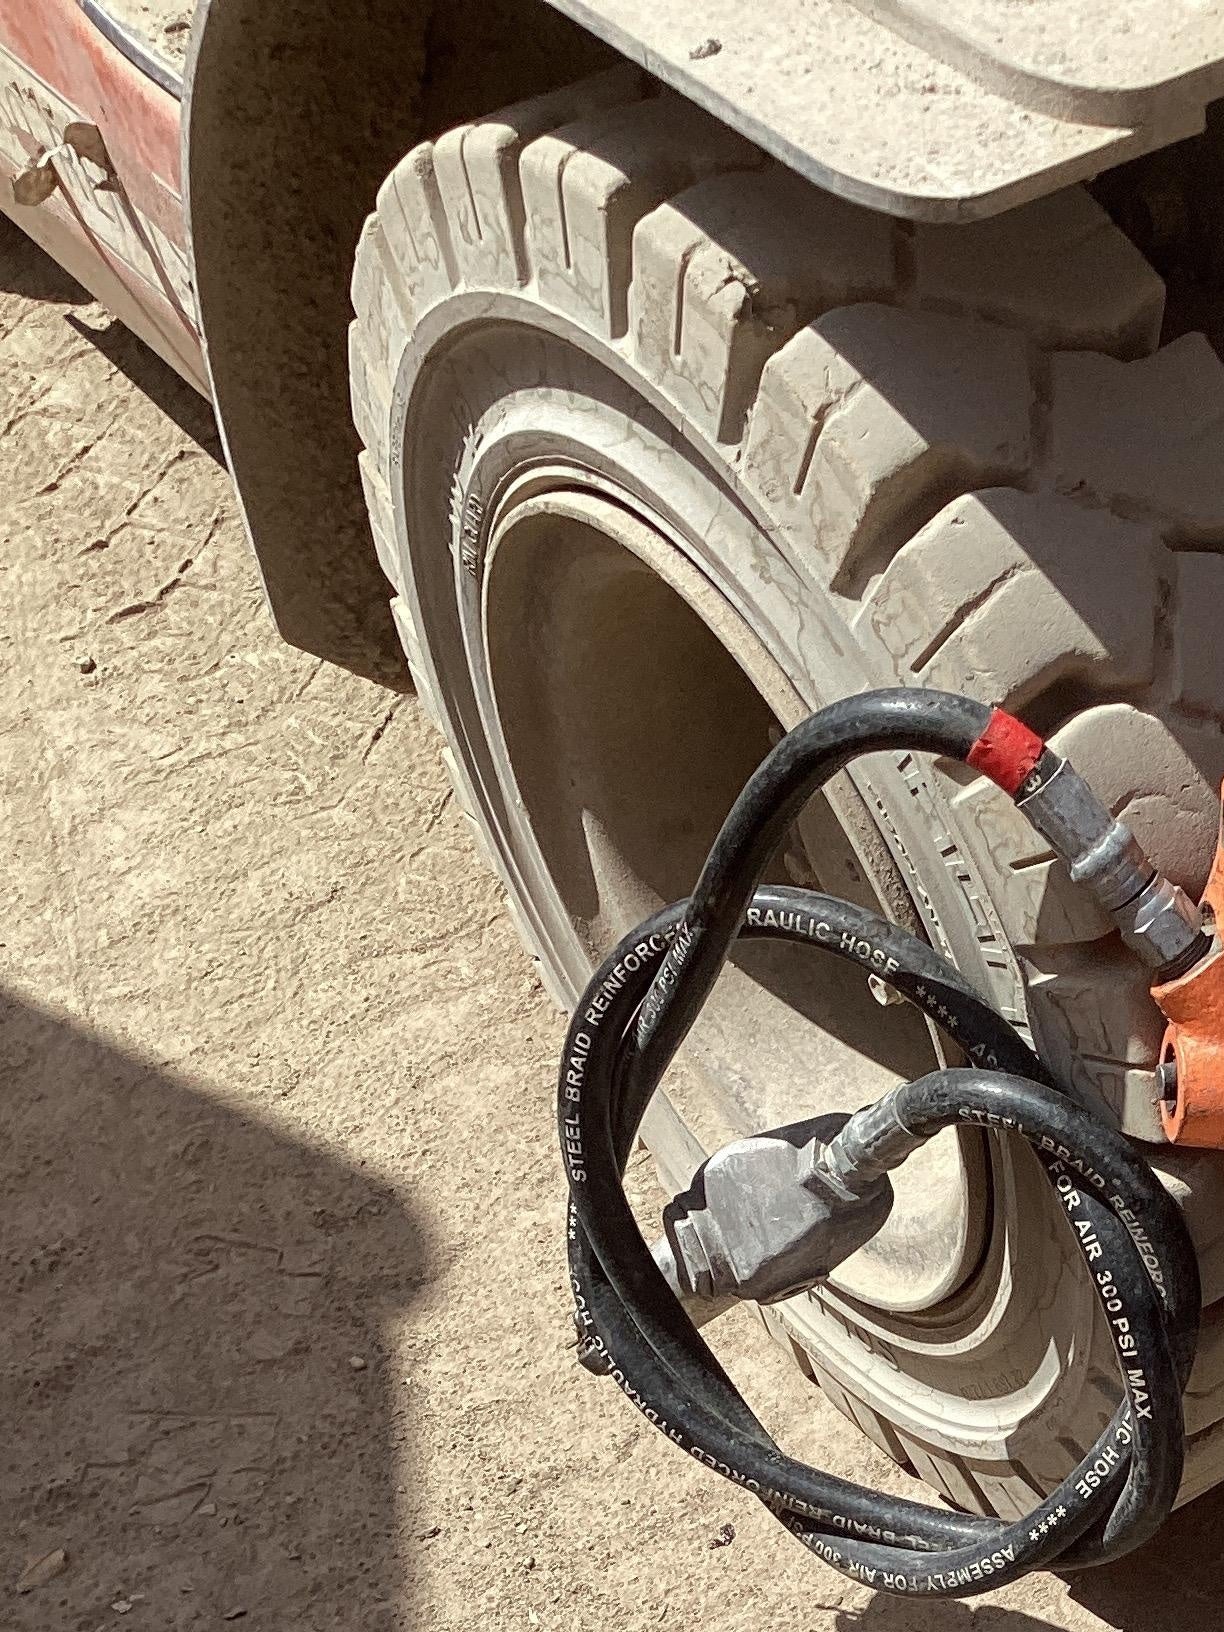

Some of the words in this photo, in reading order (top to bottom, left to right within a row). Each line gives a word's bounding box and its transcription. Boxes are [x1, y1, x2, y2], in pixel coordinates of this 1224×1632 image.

[584, 921, 683, 1026] REINFORCE
[839, 931, 901, 976] HOSE
[565, 1031, 593, 1102] BRAID
[566, 1113, 587, 1183] STEEL
[1040, 1134, 1106, 1190] BRAID
[1048, 1160, 1081, 1212] FOR
[1074, 1219, 1102, 1262] AIR
[1096, 1269, 1123, 1313] 300
[1113, 1318, 1138, 1359] PSI
[1127, 1368, 1153, 1420] MAX
[591, 1334, 683, 1442] HYDRAULIC
[1074, 1444, 1120, 1500] HOSE
[832, 1513, 896, 1544] BRAID
[848, 1558, 877, 1584] AIR
[883, 1570, 919, 1592] FOR
